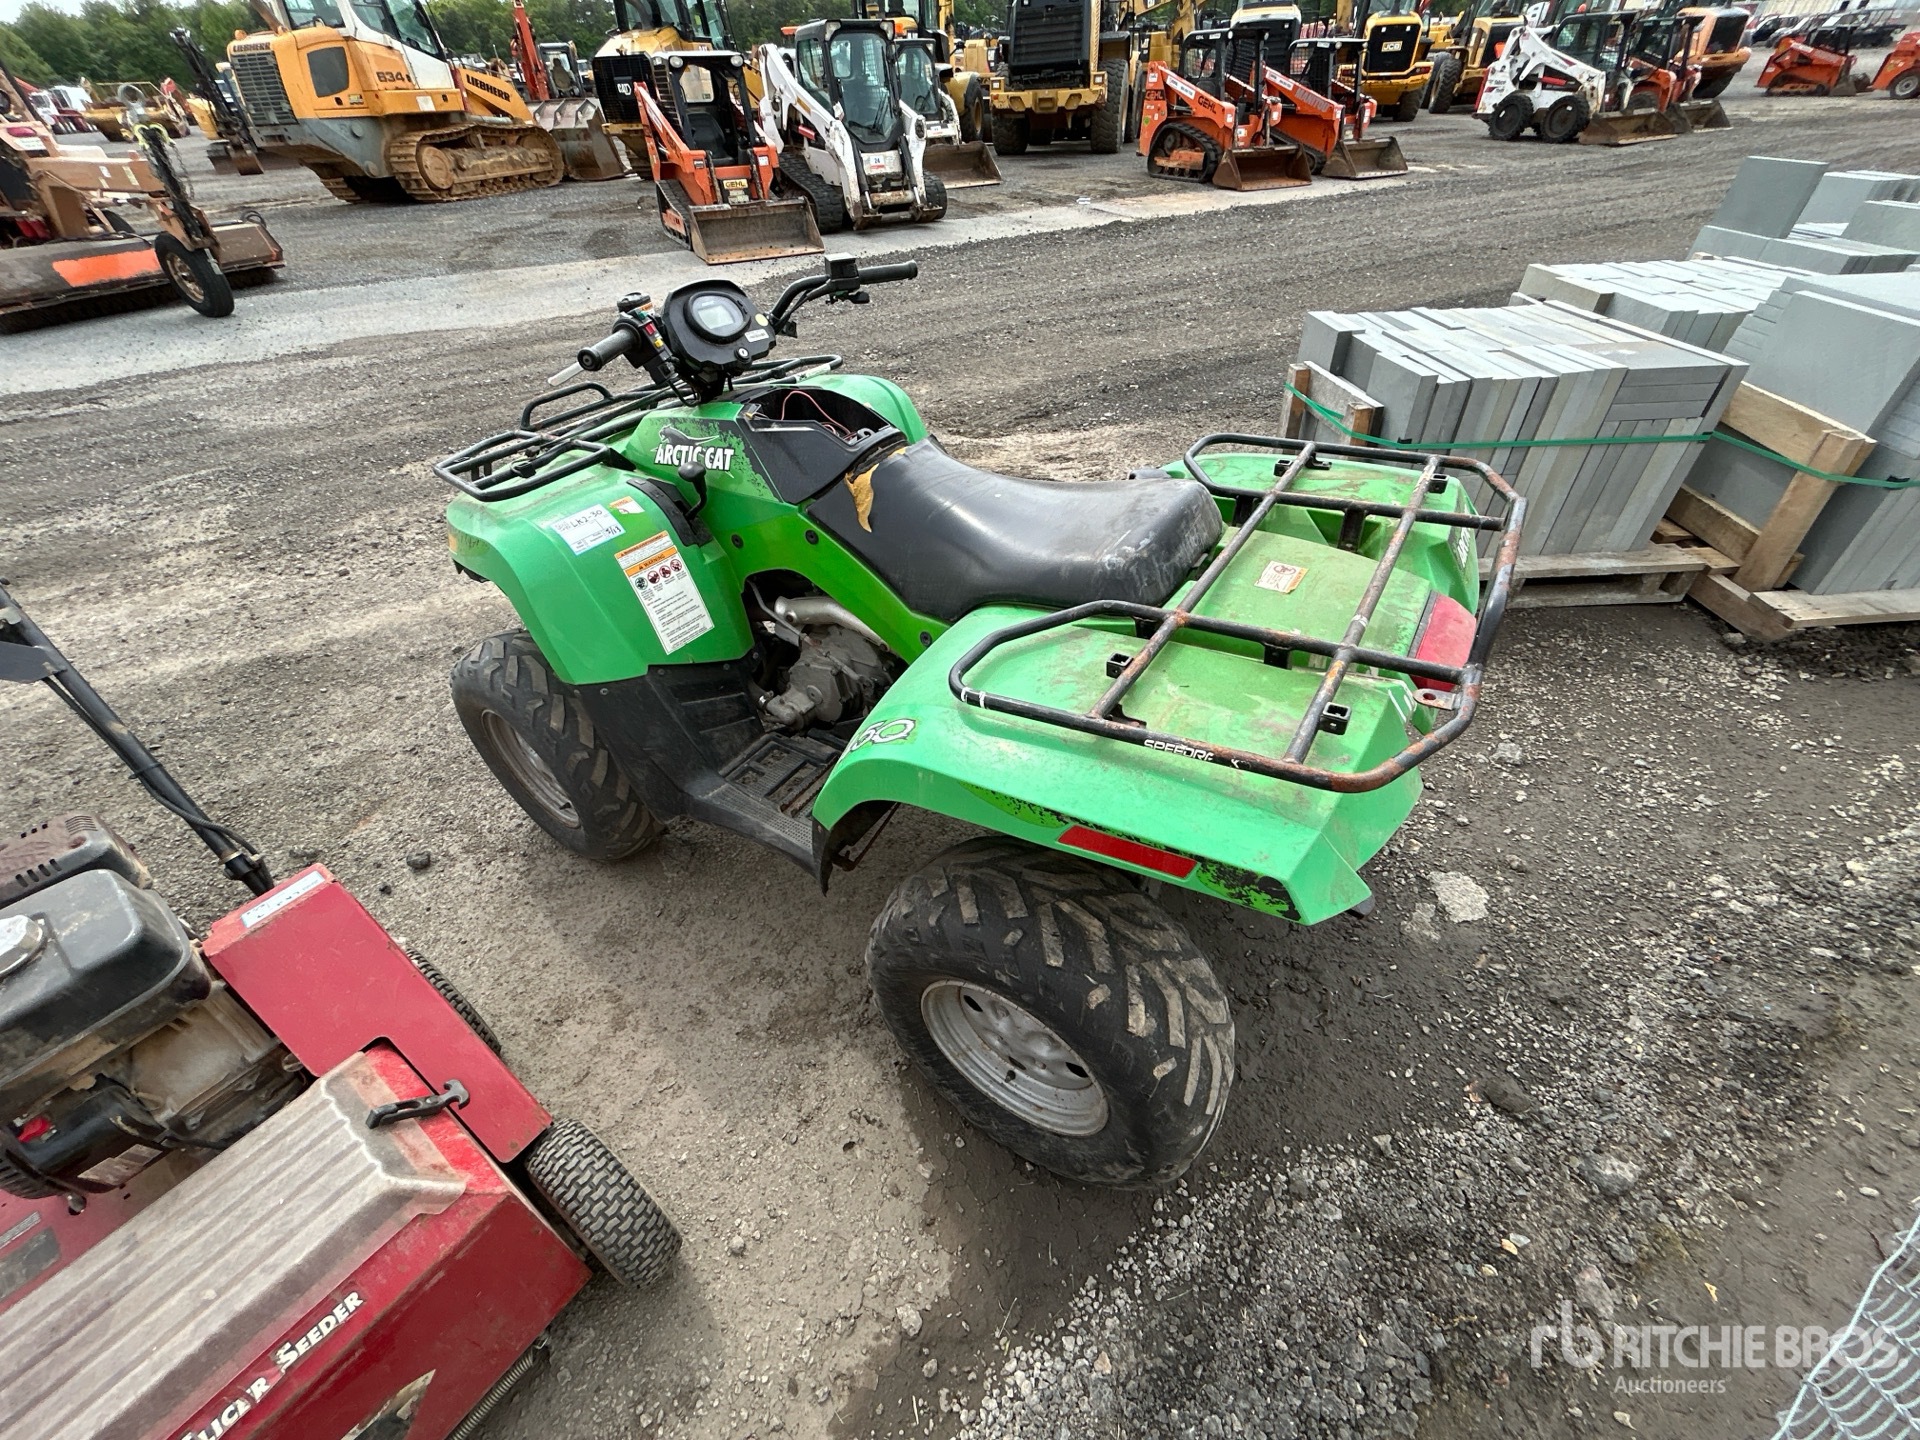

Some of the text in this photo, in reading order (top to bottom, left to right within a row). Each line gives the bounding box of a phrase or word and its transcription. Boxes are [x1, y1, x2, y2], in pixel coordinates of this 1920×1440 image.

[466, 74, 511, 102] LIEBHERR
[1197, 95, 1217, 114] GEHL
[655, 443, 735, 471] ARCTIC CAT
[275, 1291, 364, 1371] SEEDER
